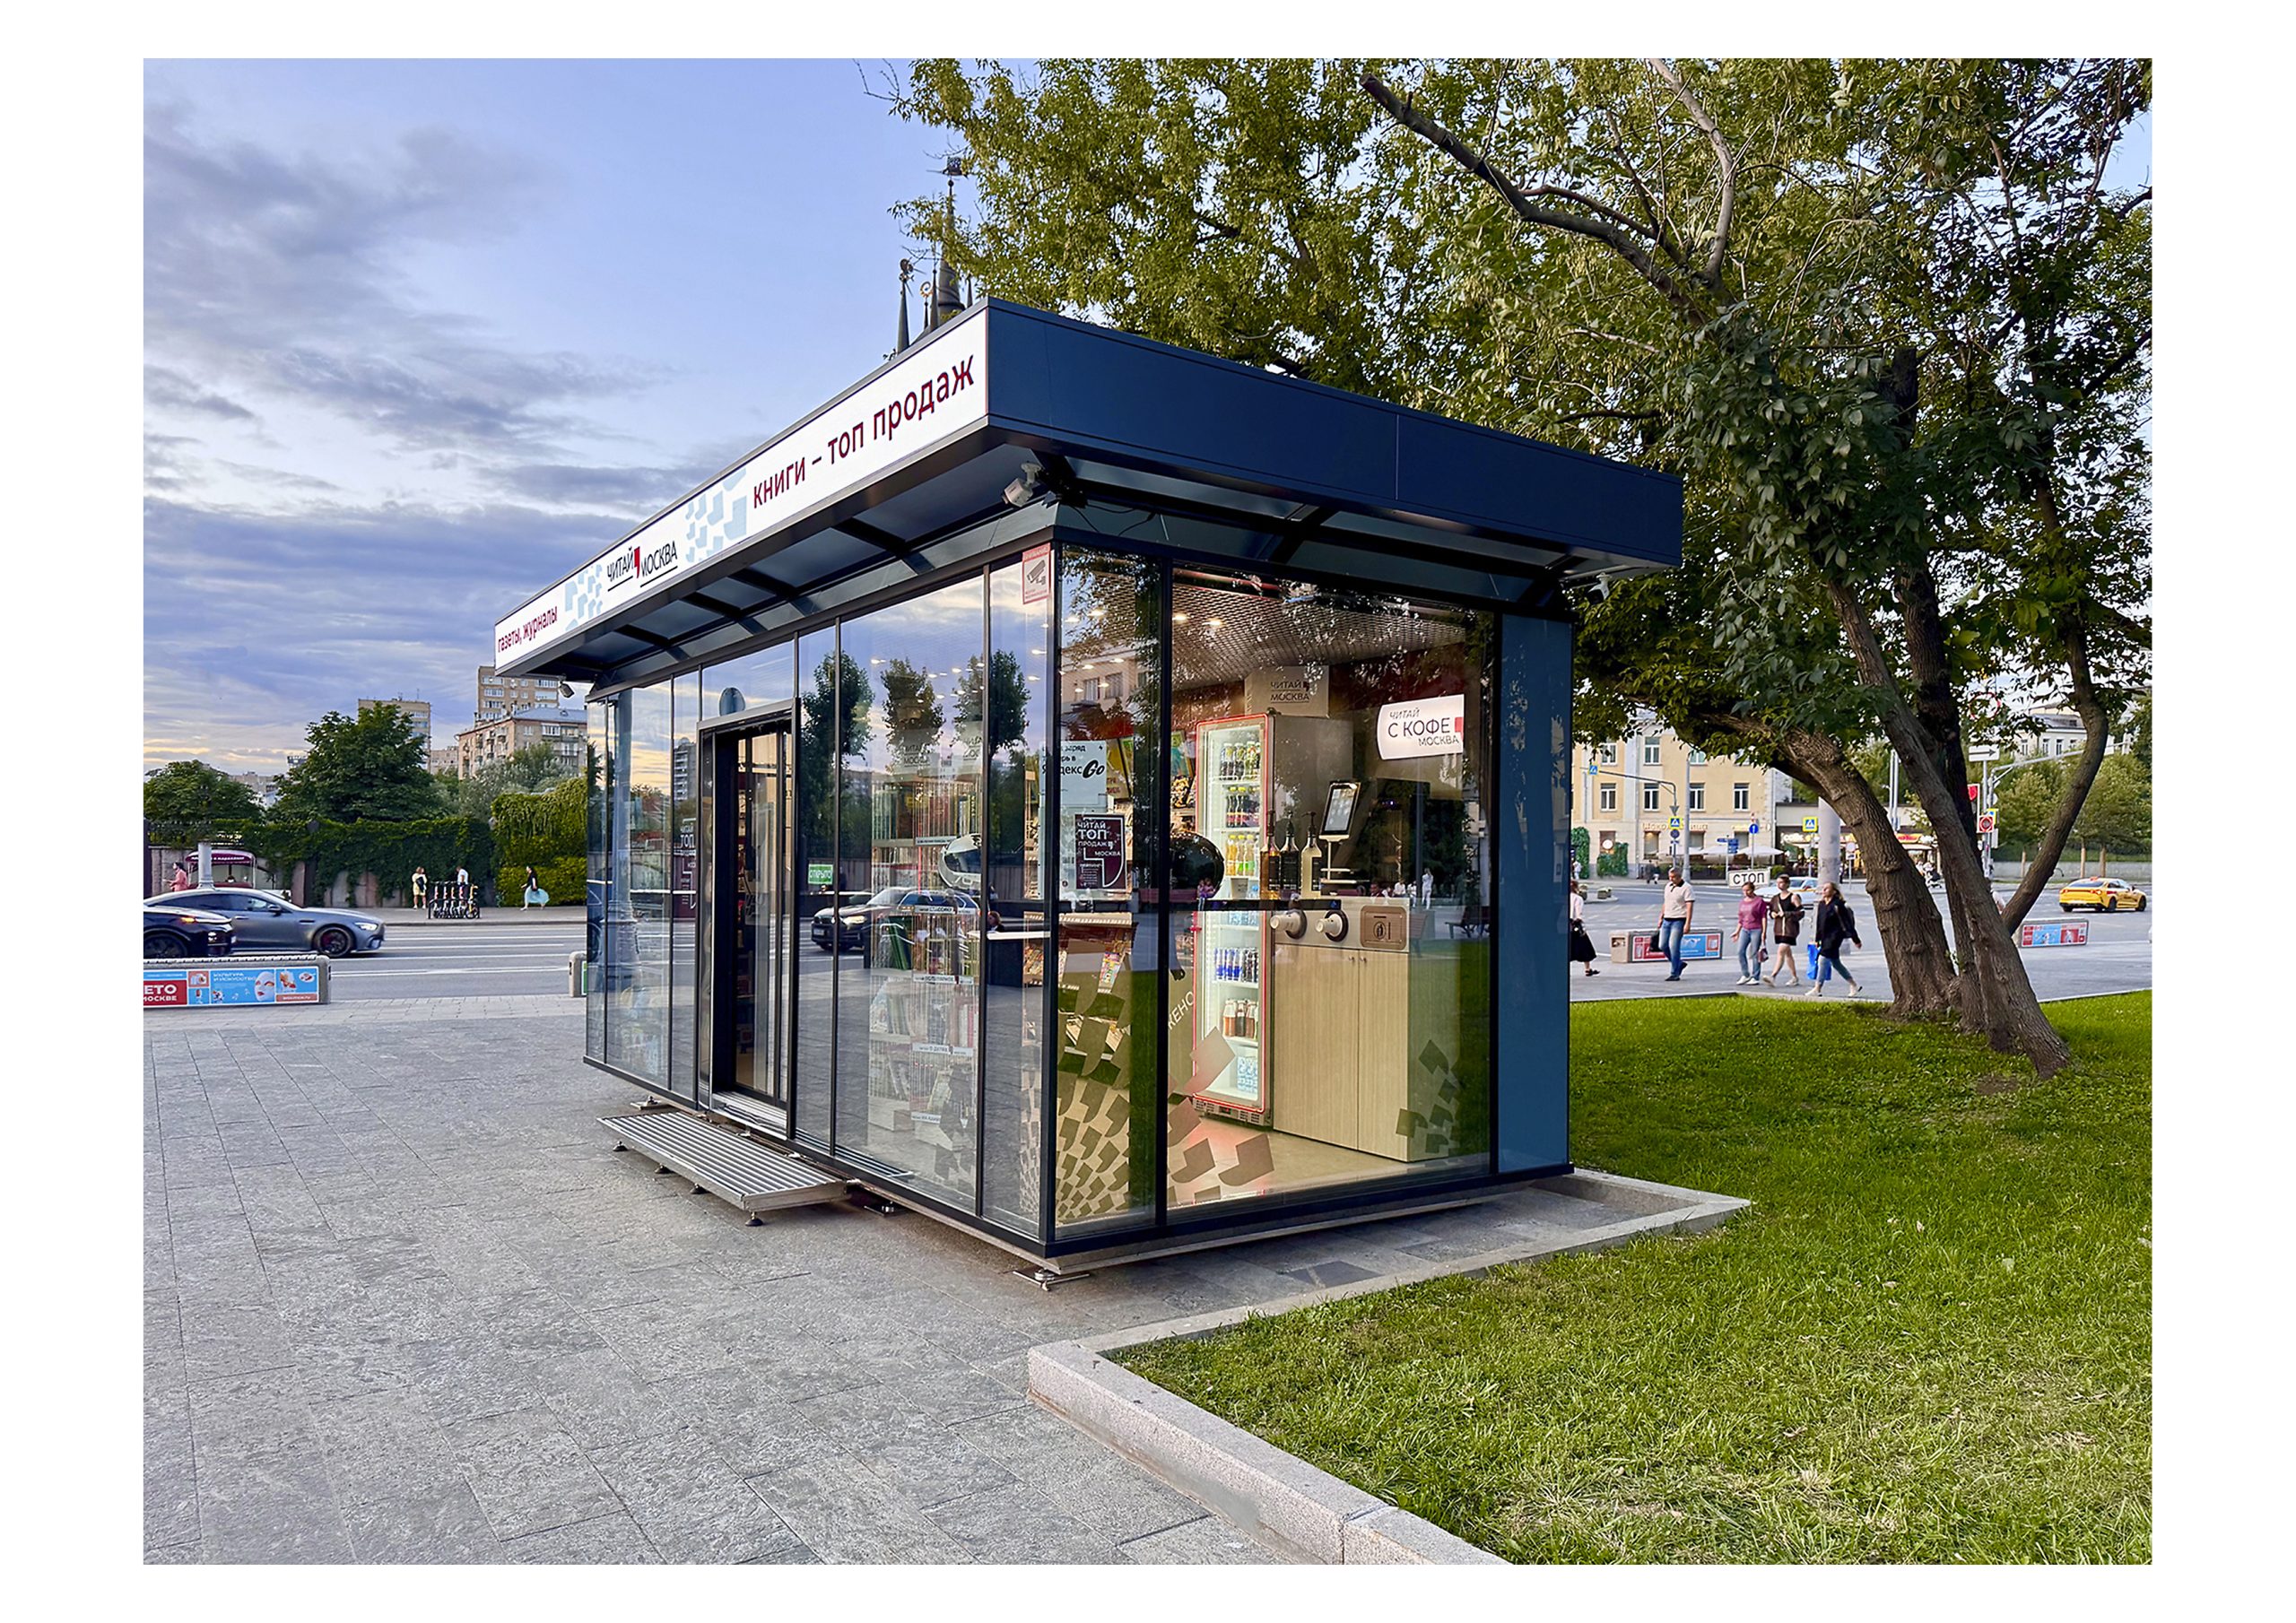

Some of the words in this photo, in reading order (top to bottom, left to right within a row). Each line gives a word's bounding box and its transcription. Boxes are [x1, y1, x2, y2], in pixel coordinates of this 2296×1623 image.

[753, 456, 805, 508] книги
[828, 421, 864, 464] топ
[874, 354, 975, 441] продаж
[606, 546, 634, 582] ЧИТАЙ
[641, 540, 678, 578] МОСКВА
[498, 628, 522, 653] газеты,
[523, 606, 558, 641] журналы
[1270, 680, 1301, 690] ЧИТАЙ
[1270, 693, 1309, 701] МОСКВА
[1390, 707, 1421, 720] ЧИТАЙ
[1387, 723, 1399, 738] С
[1403, 717, 1451, 737] КОФЕ
[1418, 734, 1460, 747] МОСКВА
[1042, 764, 1083, 776] Ядекс
[1083, 759, 1105, 779] Go
[1077, 820, 1106, 829] ЧИТАЙ
[1077, 829, 1107, 840] ТОП
[1733, 872, 1765, 885] СТОП
[144, 984, 178, 994] ЕТО
